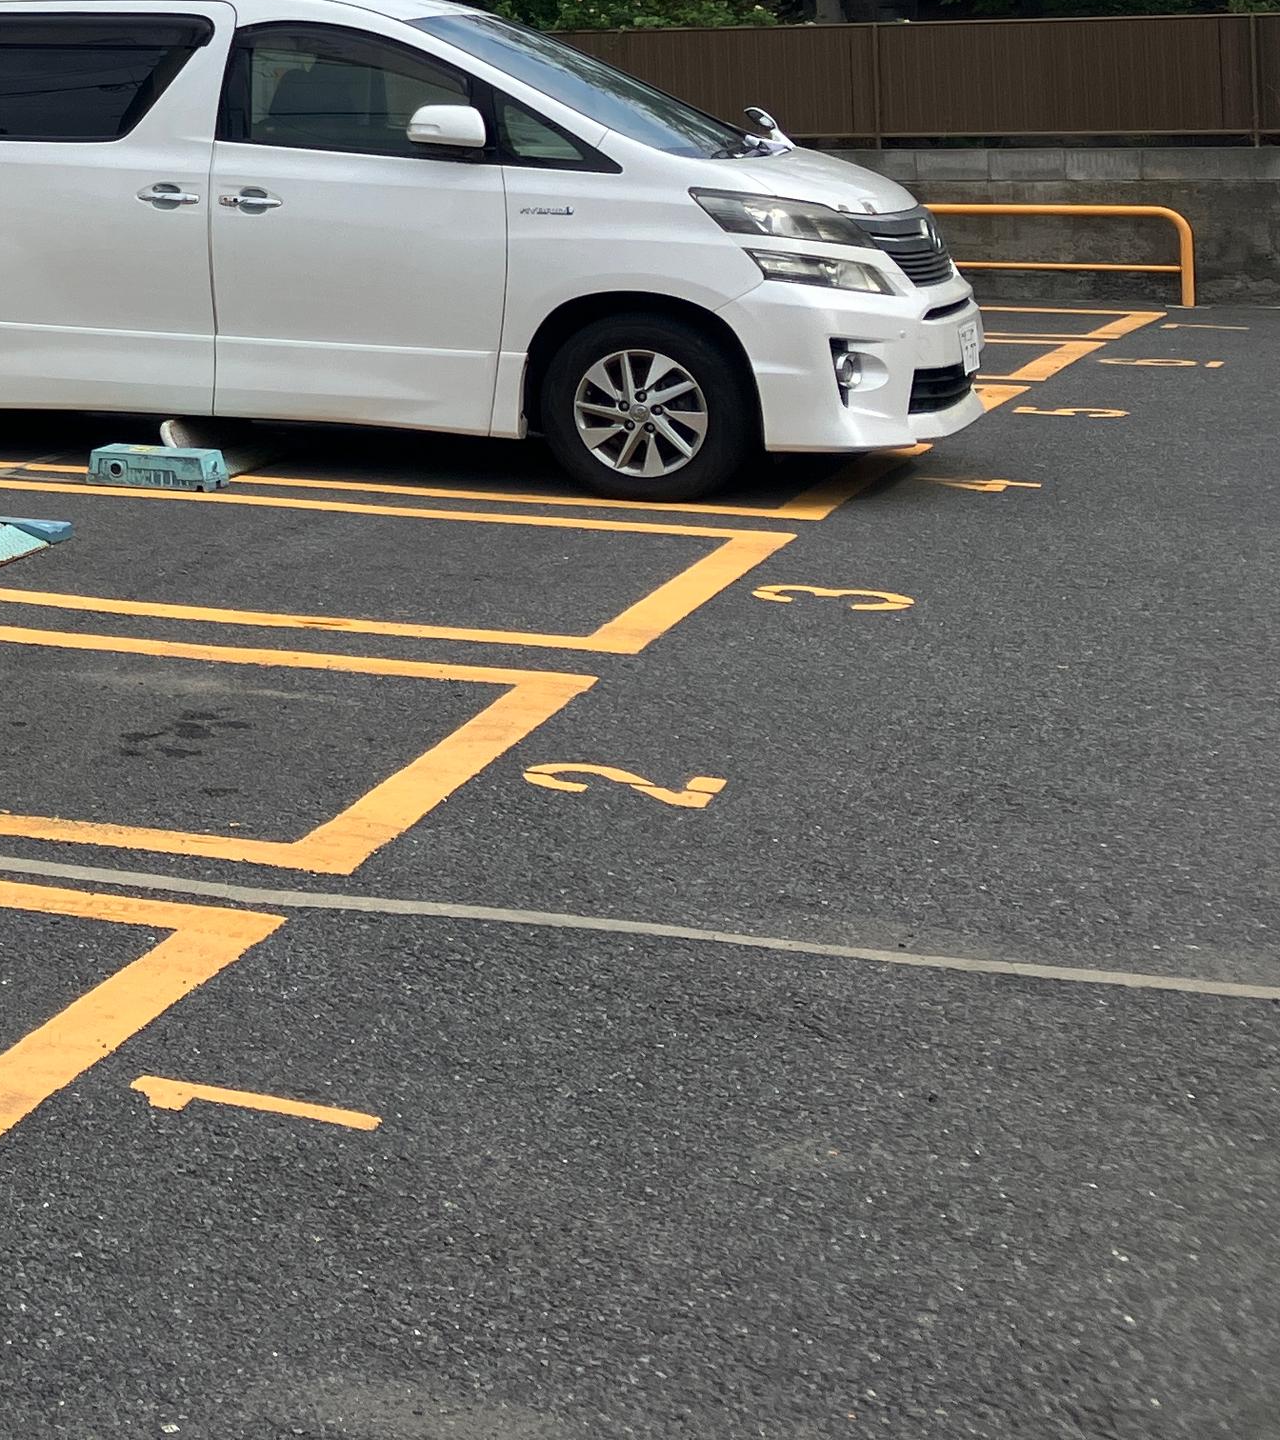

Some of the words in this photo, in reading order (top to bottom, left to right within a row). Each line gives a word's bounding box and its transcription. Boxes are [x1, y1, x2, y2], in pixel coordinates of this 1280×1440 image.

[1012, 406, 1131, 418] 5
[752, 583, 915, 612] 3
[523, 762, 727, 808] 2
[129, 1074, 382, 1130] 1
